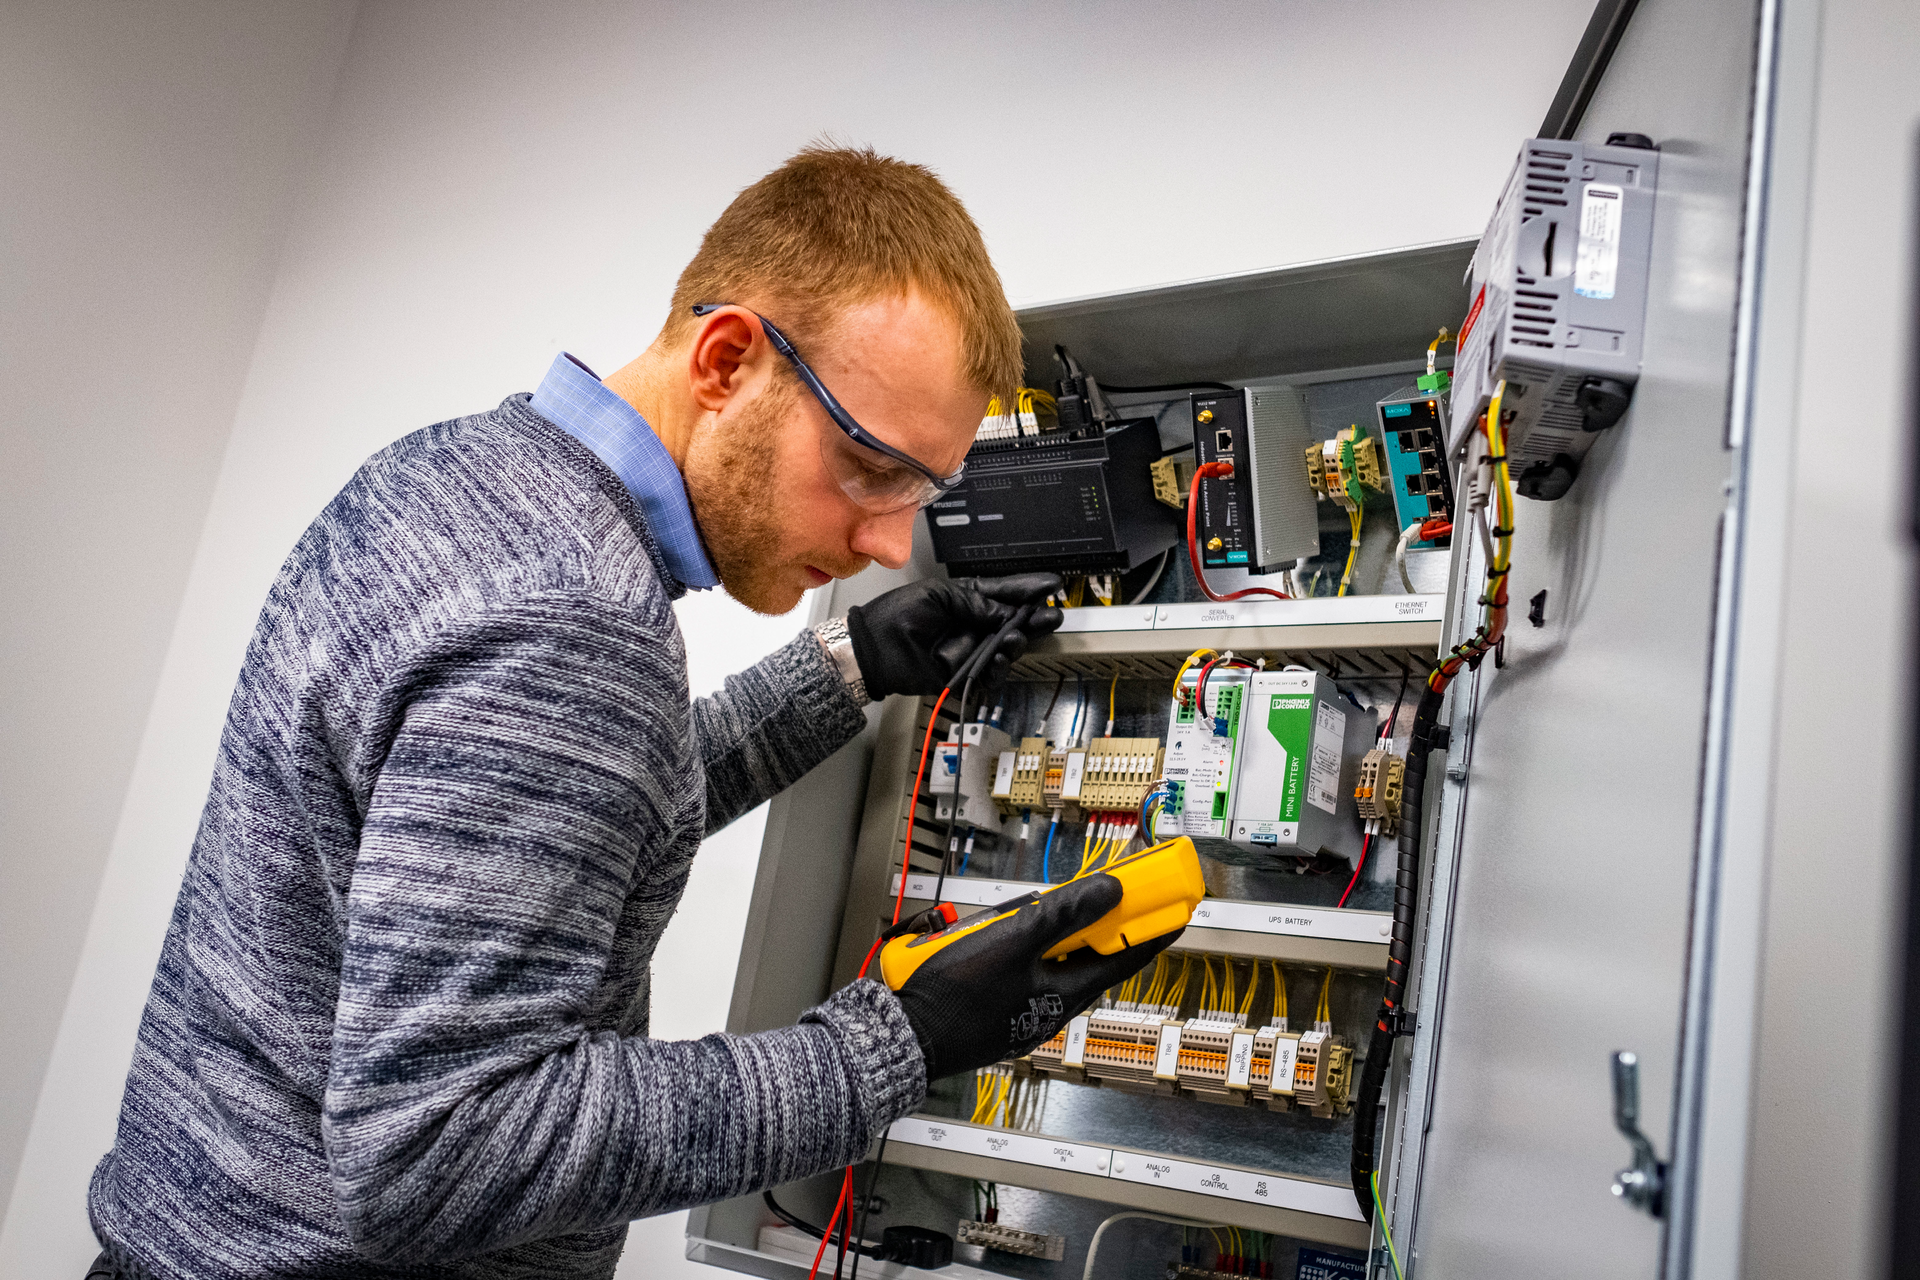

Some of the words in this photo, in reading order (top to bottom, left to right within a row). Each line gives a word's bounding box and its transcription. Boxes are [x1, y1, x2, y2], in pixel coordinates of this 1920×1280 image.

[1395, 601, 1428, 609] ETHERNET
[1398, 607, 1424, 615] SWITCH
[1201, 614, 1235, 622] CONVERTER
[1288, 756, 1300, 796] BATTERY
[1268, 916, 1282, 924] UPS
[1285, 917, 1312, 926] BATTERY
[1235, 1053, 1240, 1063] CB
[1239, 1043, 1248, 1074] TRIPPING
[1280, 1050, 1290, 1078] RS-485
[928, 1127, 947, 1136] DIGITAL
[987, 1137, 1008, 1146] ANALOG
[1053, 1148, 1074, 1158] DIGITAL
[1146, 1163, 1170, 1173] ANALOG
[1201, 1180, 1229, 1190] CONTROL
[1254, 1189, 1268, 1197] 485
[1316, 1257, 1366, 1272] MANUFACTUR
